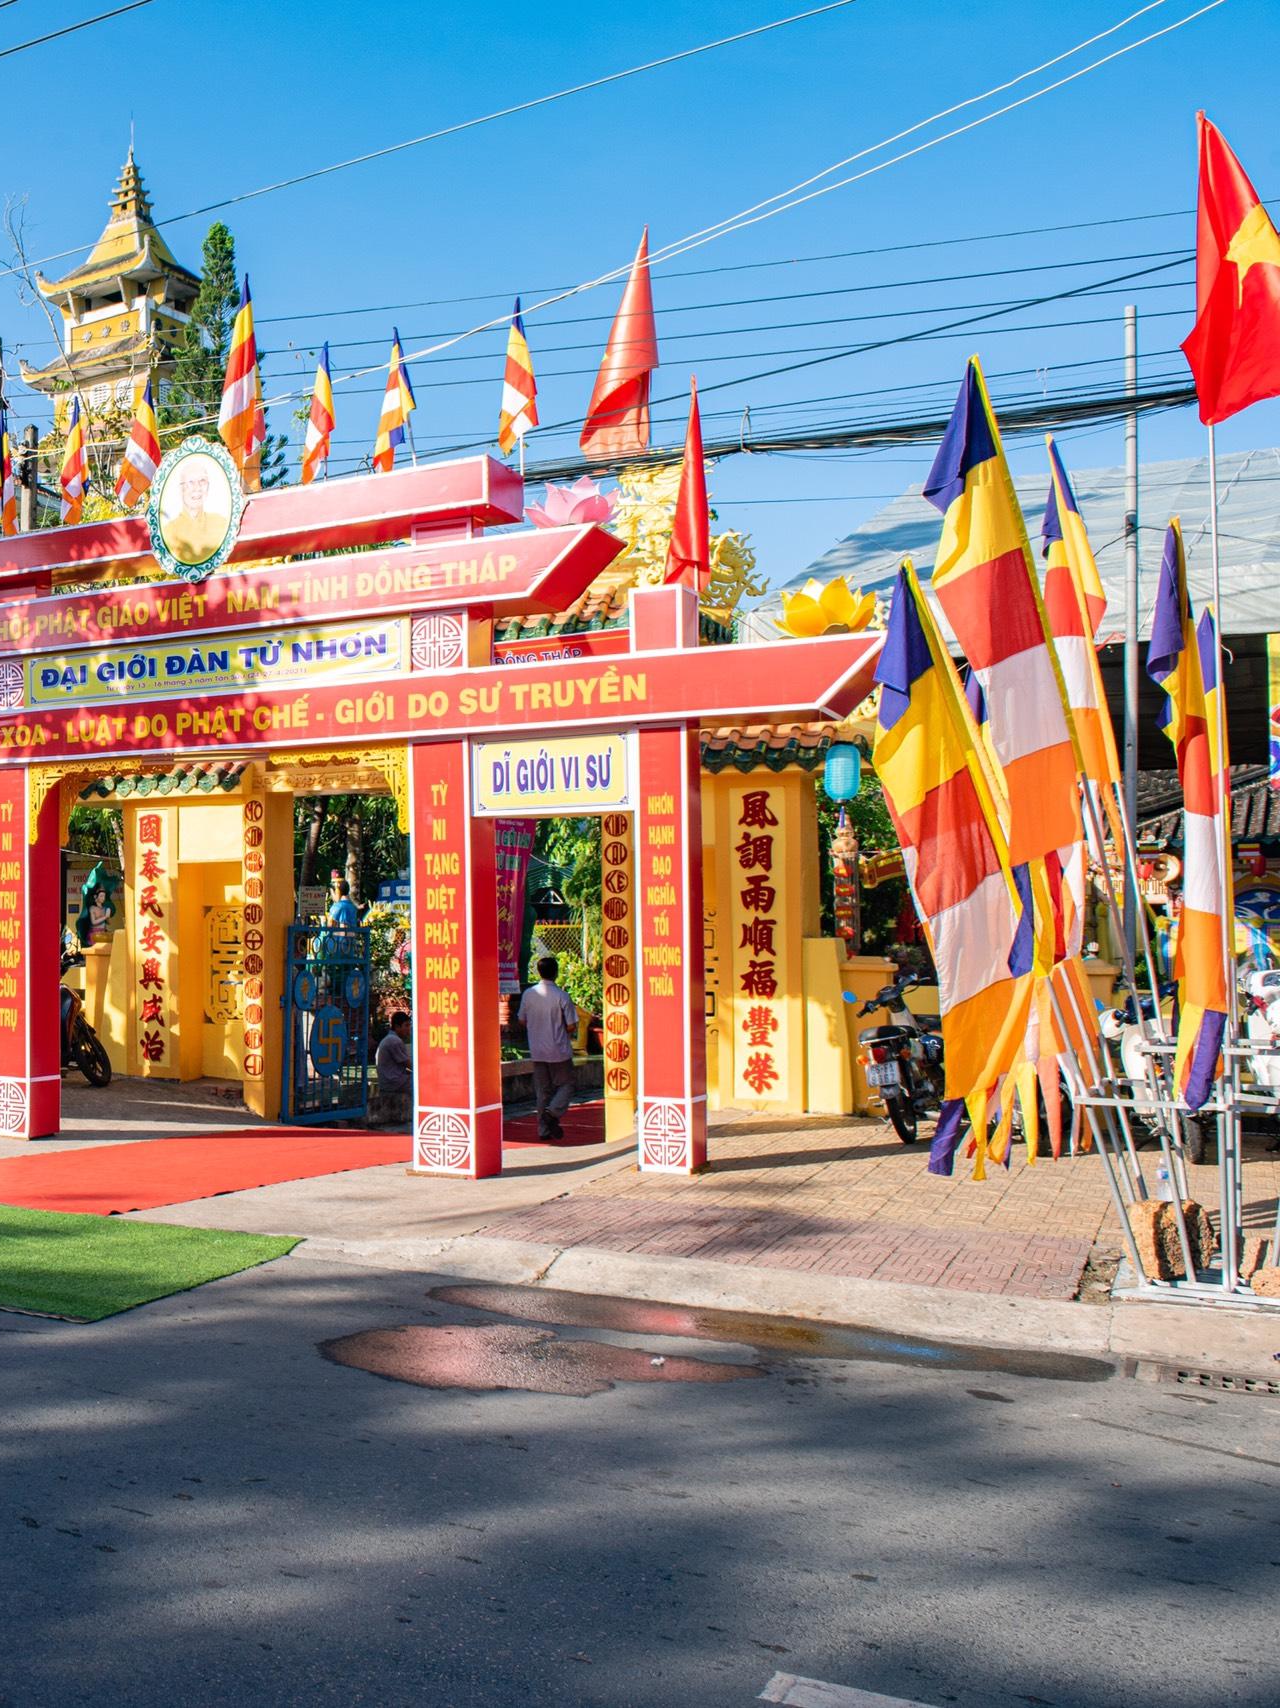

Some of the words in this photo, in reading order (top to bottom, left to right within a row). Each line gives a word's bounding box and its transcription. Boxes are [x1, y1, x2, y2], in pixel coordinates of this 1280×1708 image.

[36, 606, 90, 638] PHẬT
[98, 598, 149, 629] GIÁO
[156, 592, 209, 625] VIỆT
[227, 585, 280, 614] NAM
[288, 571, 348, 605] TỈNH
[355, 559, 432, 596] ĐỒNG
[441, 553, 518, 587] THÁP
[41, 665, 88, 693] ĐẠI
[96, 654, 157, 682] GIỚI
[166, 646, 228, 676] ĐÀN
[239, 639, 283, 668] TỪ
[0, 724, 46, 748] XOA
[66, 715, 127, 747] LUẬT
[134, 711, 169, 738] DO
[176, 701, 246, 740] PHẬT
[254, 694, 310, 731] CHẾ
[335, 692, 395, 725] GIỚI
[408, 691, 449, 718] DO
[458, 681, 503, 715] SƯ
[509, 665, 647, 711] TRUYỀN
[492, 751, 511, 794] DĨ
[516, 749, 555, 793] GIỚI
[561, 756, 580, 791] VI
[586, 747, 612, 789] SƯ
[430, 779, 449, 807] TỲ
[0, 799, 13, 822] TỲ
[1, 833, 13, 852] NI
[432, 819, 447, 841] NI
[648, 825, 675, 849] HẠNH
[424, 852, 460, 880] TẠNG
[652, 856, 672, 880] ĐẠO
[426, 883, 456, 915] DIỆT
[647, 882, 677, 906] NGHĨA
[424, 918, 459, 950] PHẬT
[653, 909, 670, 937] TỐI
[734, 789, 779, 1095] 風調雨順福豐榮
[425, 952, 460, 980] PHÁP
[428, 987, 460, 1018] DIỆC
[429, 1021, 459, 1053] DIỆT
